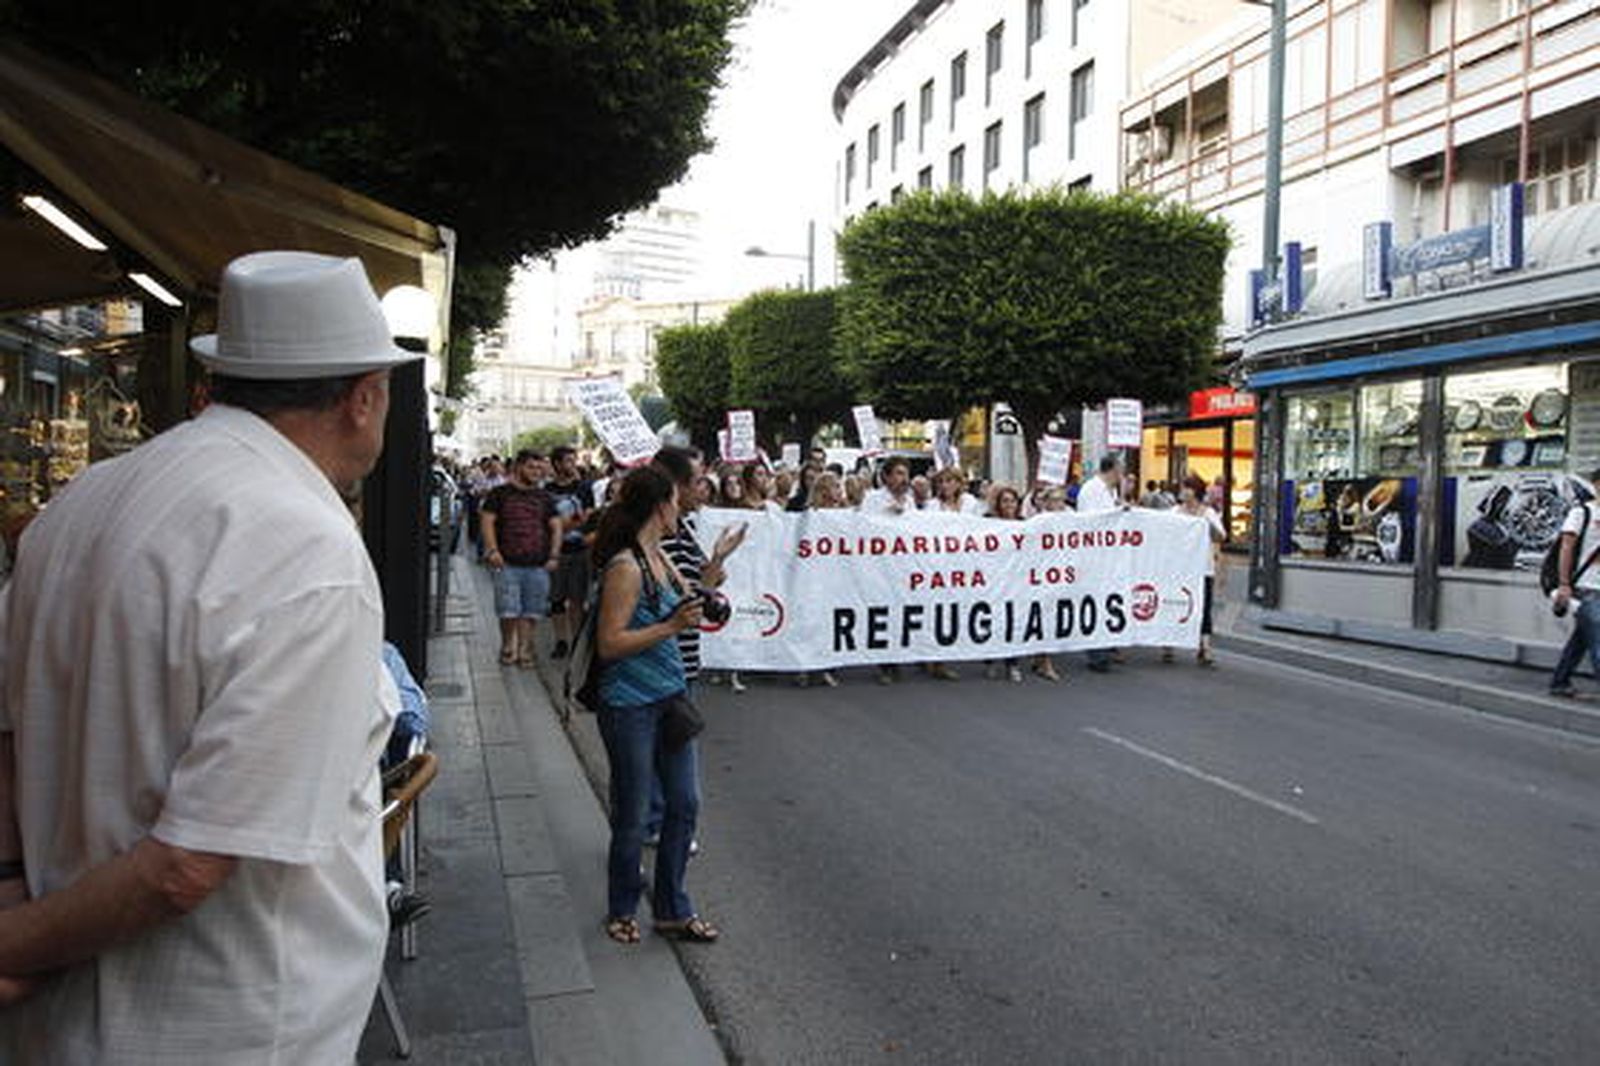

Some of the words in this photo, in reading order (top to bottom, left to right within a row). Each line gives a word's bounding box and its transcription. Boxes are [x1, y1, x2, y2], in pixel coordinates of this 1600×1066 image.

[798, 535, 999, 559] SOLIDARIDAD
[1011, 534, 1025, 550] Y
[1042, 531, 1143, 550] DIGNIDAD
[910, 570, 986, 591] PARA
[1030, 566, 1076, 585] LOS
[833, 593, 1126, 652] REFUGIADOS
